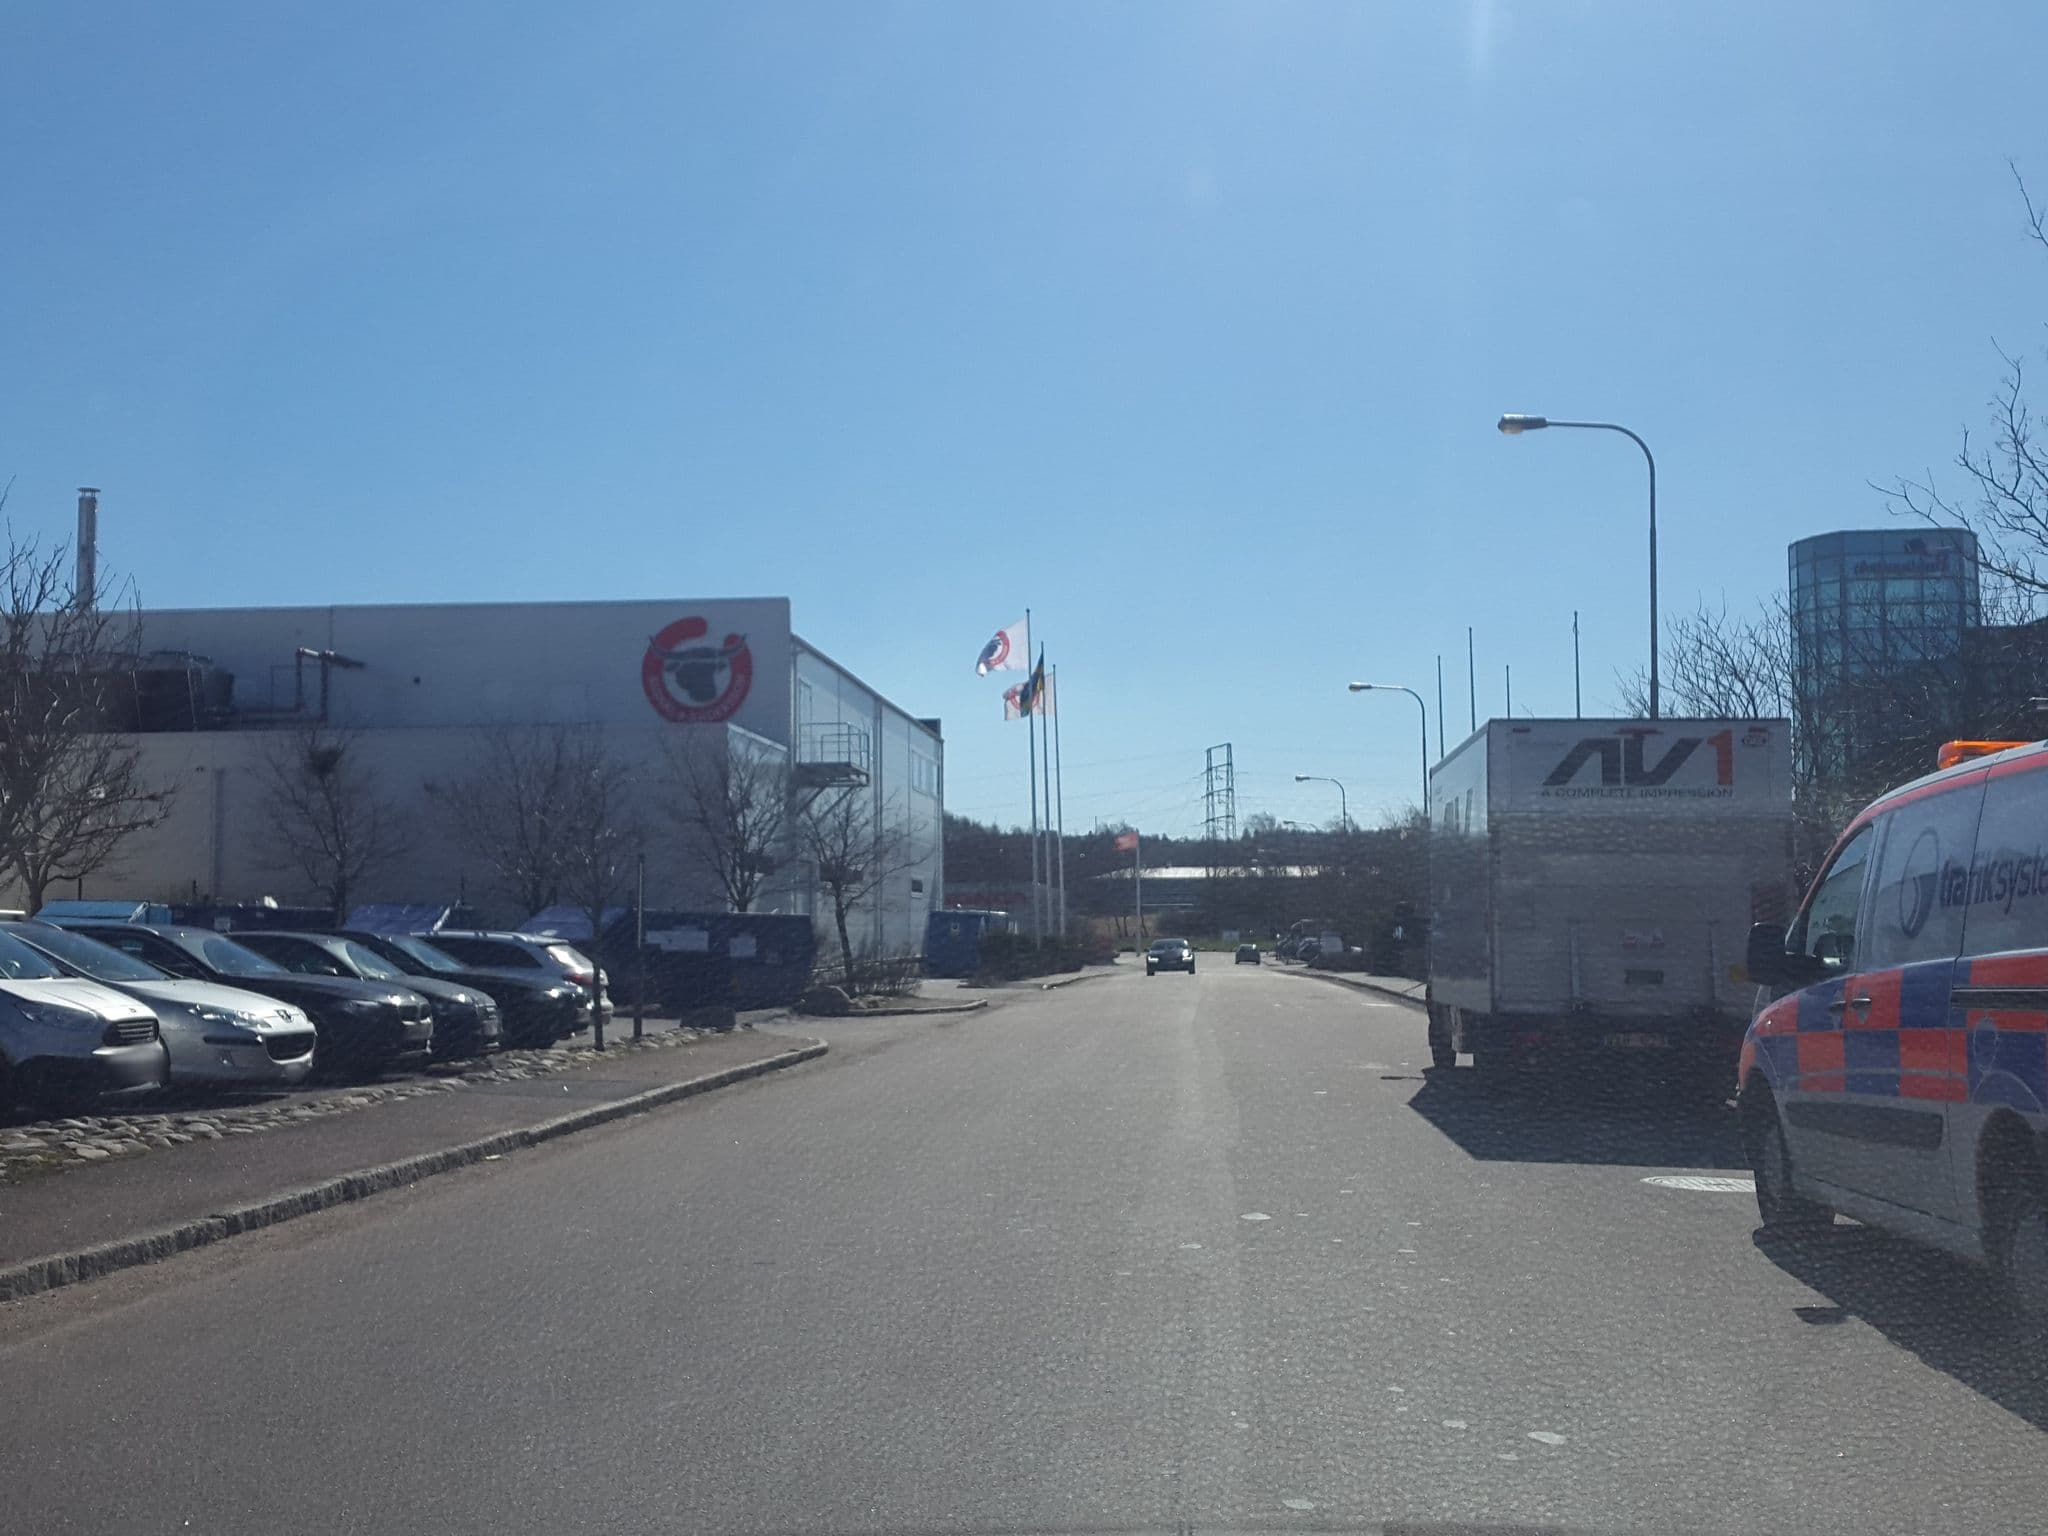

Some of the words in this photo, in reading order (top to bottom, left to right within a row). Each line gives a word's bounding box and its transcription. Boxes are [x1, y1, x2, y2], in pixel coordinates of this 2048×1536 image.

[1541, 788, 1551, 798] A
[1555, 787, 1636, 799] COMPLETE
[1640, 787, 1734, 798] IMPRESSION
